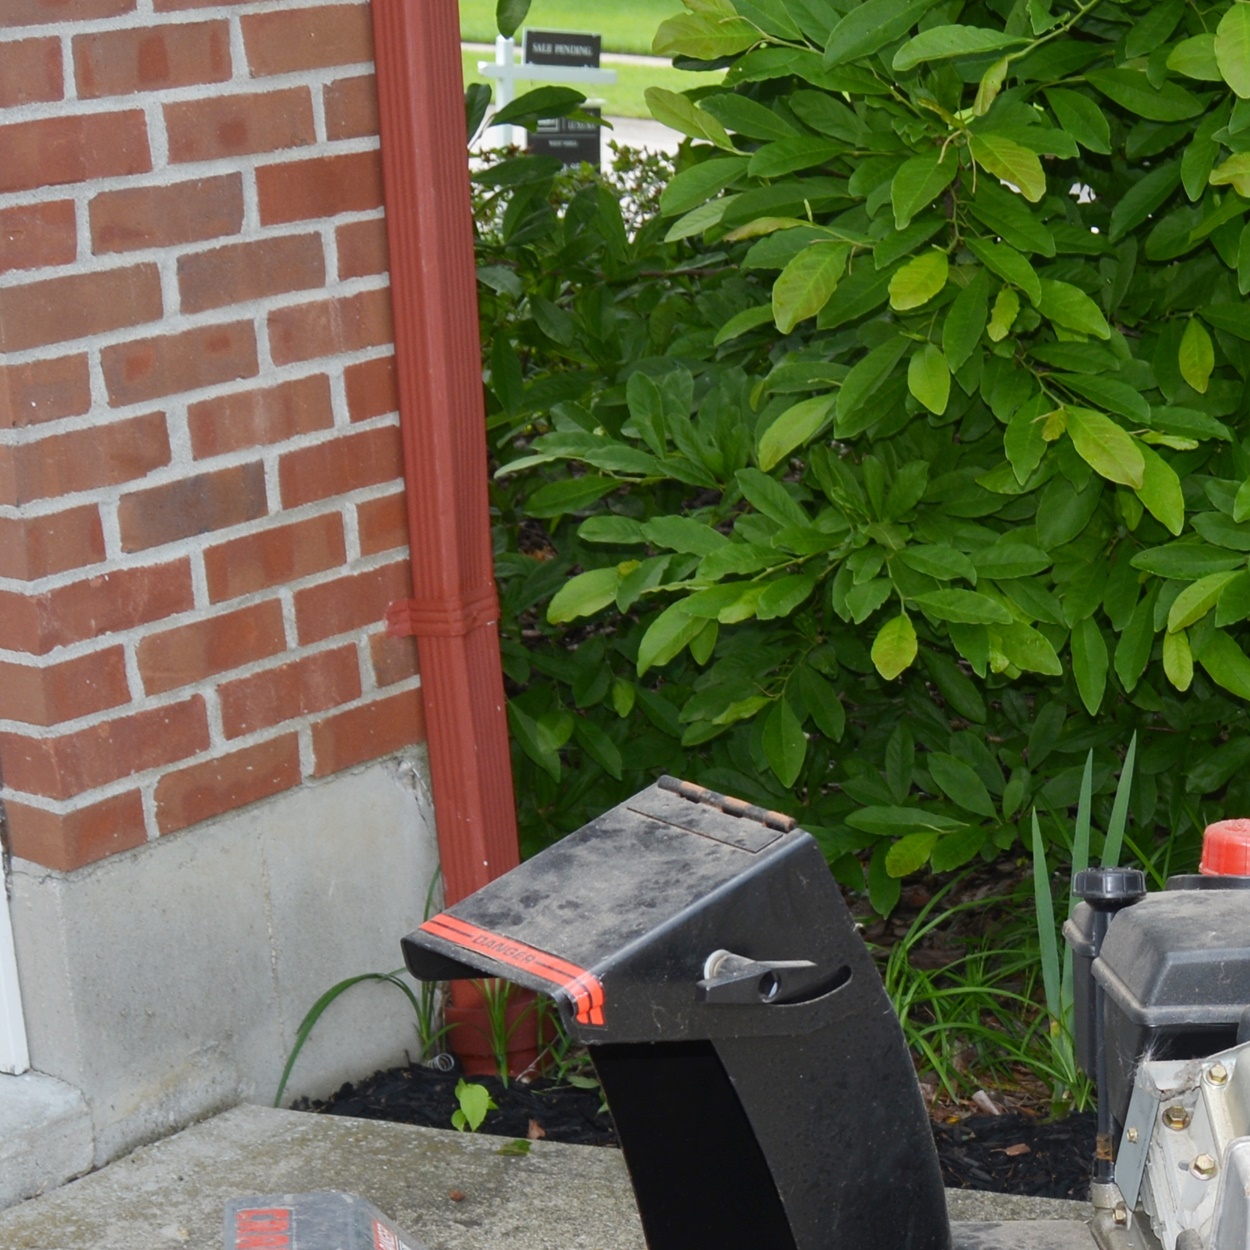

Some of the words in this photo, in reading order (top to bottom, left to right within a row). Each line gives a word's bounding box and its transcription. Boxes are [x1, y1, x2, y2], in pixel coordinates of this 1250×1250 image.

[532, 43, 552, 54] SALE
[554, 44, 593, 57] PENDING
[472, 934, 537, 964] DANGER
